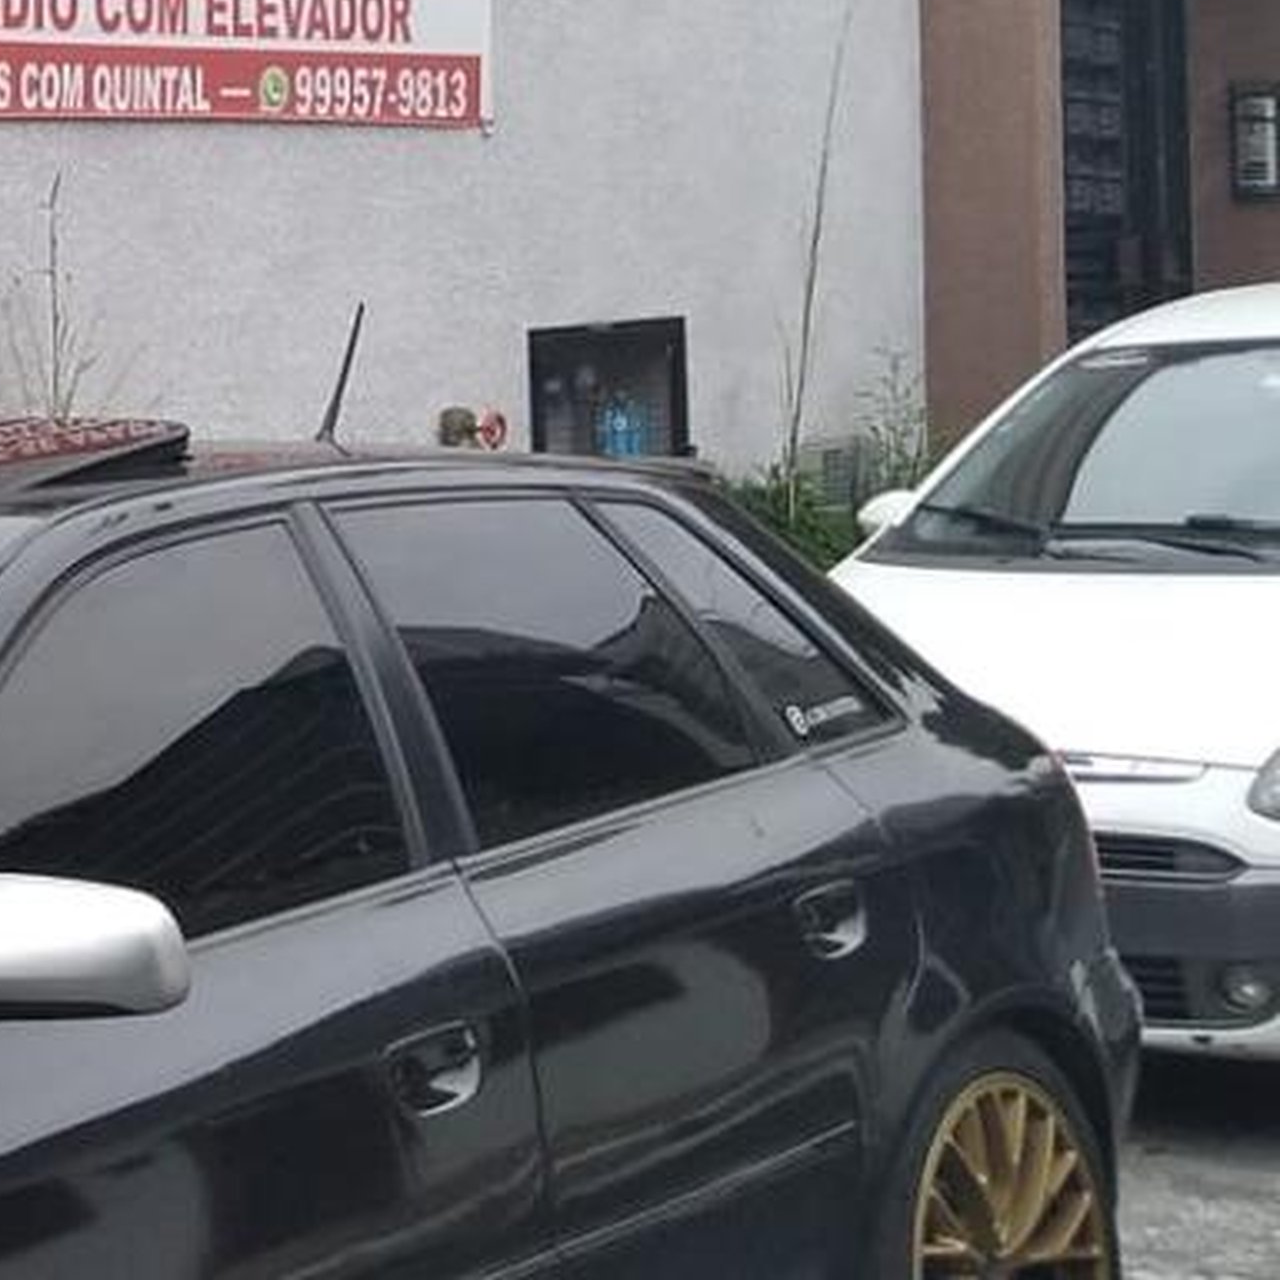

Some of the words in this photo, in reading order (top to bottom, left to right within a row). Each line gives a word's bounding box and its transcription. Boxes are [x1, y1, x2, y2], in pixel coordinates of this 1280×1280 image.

[20, 64, 85, 111] COM
[92, 64, 211, 113] QUINTAL
[294, 67, 469, 119] 99957-9813
